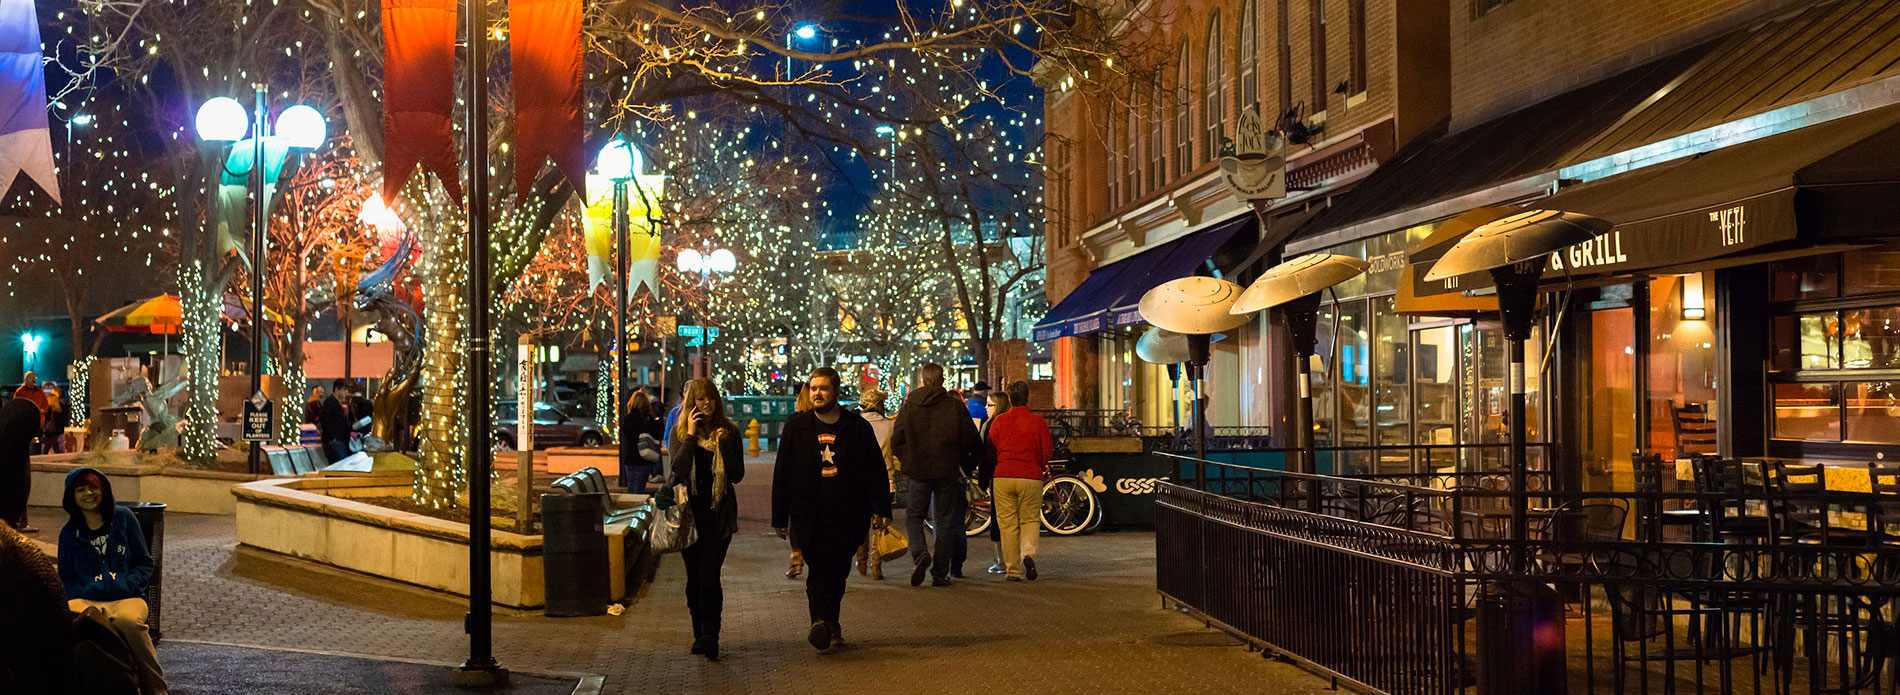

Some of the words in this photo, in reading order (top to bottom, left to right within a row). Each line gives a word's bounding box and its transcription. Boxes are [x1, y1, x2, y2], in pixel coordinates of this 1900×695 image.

[1708, 211, 1719, 222] THE
[1719, 205, 1746, 247] YETI
[1569, 231, 1627, 269] GRILL
[117, 544, 126, 556] 87
